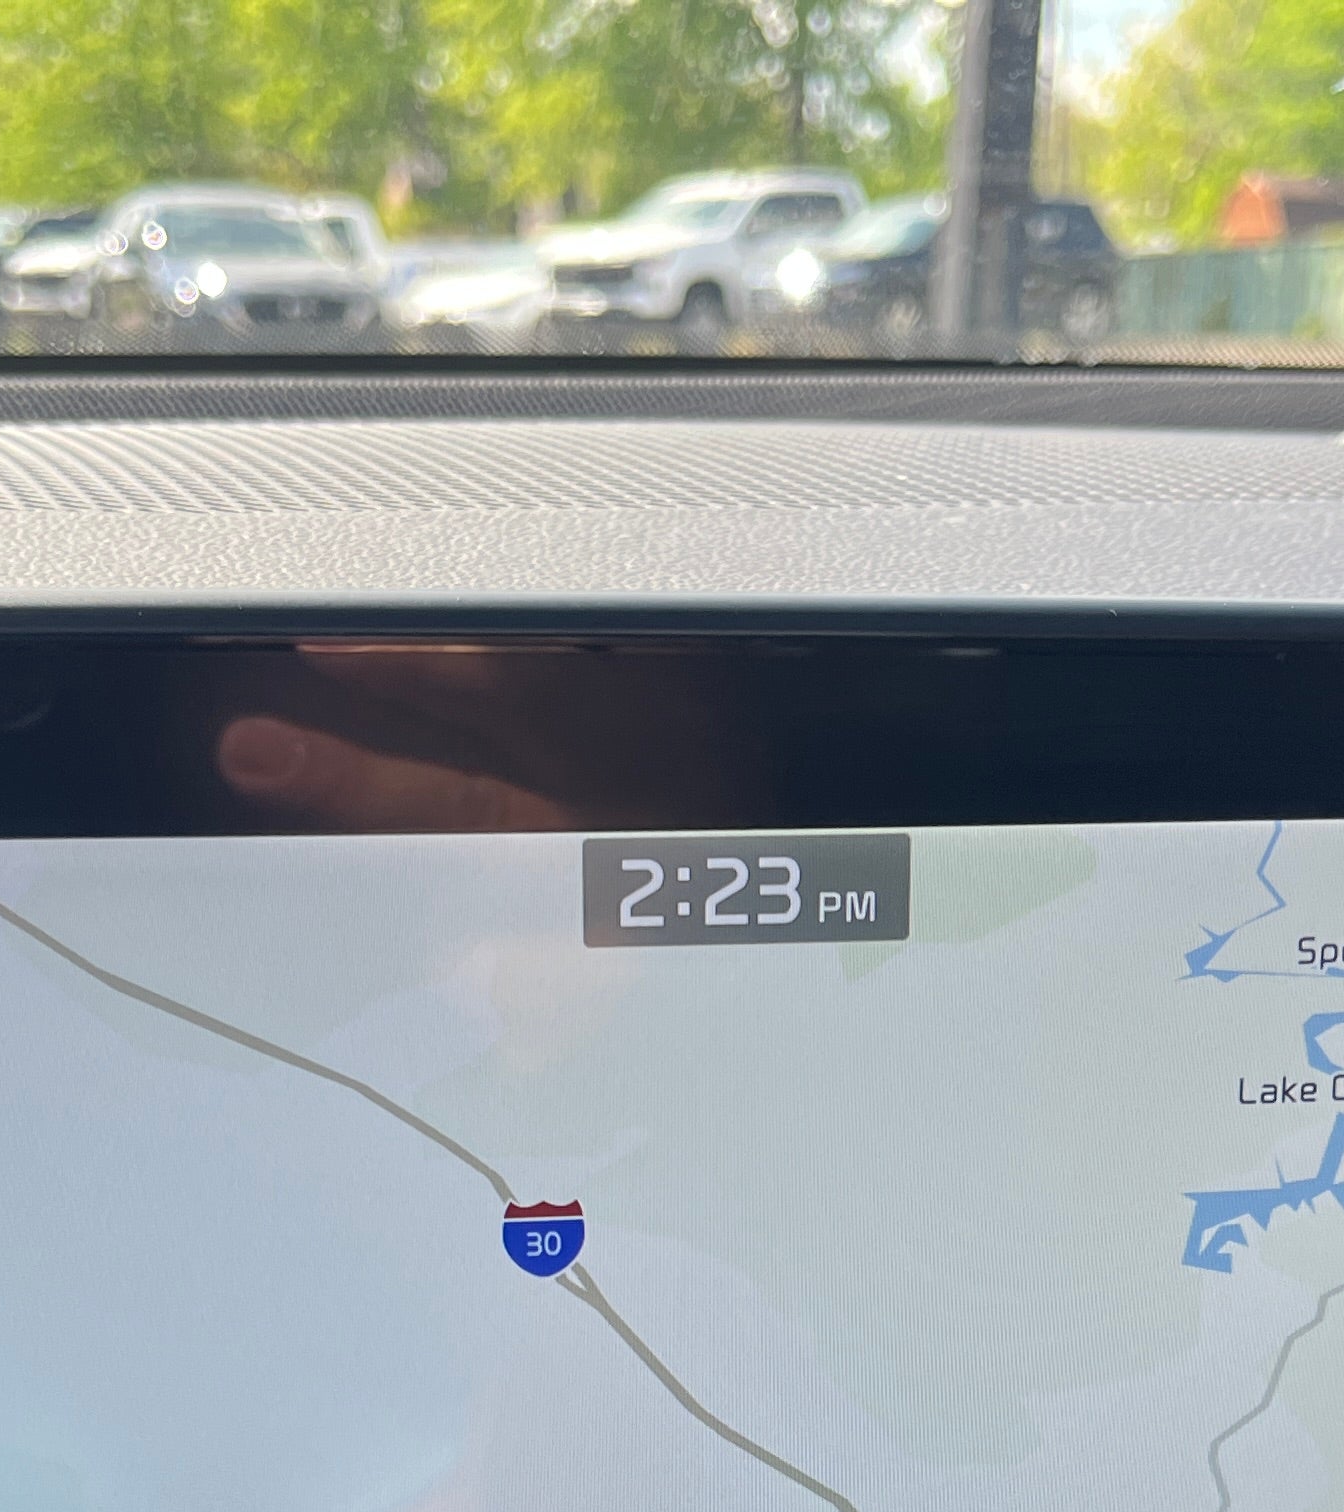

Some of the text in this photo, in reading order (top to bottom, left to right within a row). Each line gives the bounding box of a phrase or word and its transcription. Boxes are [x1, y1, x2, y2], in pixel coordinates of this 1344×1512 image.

[619, 856, 876, 928] 2:23 PM
[1238, 1075, 1318, 1105] Lake
[525, 1230, 563, 1258] 30
